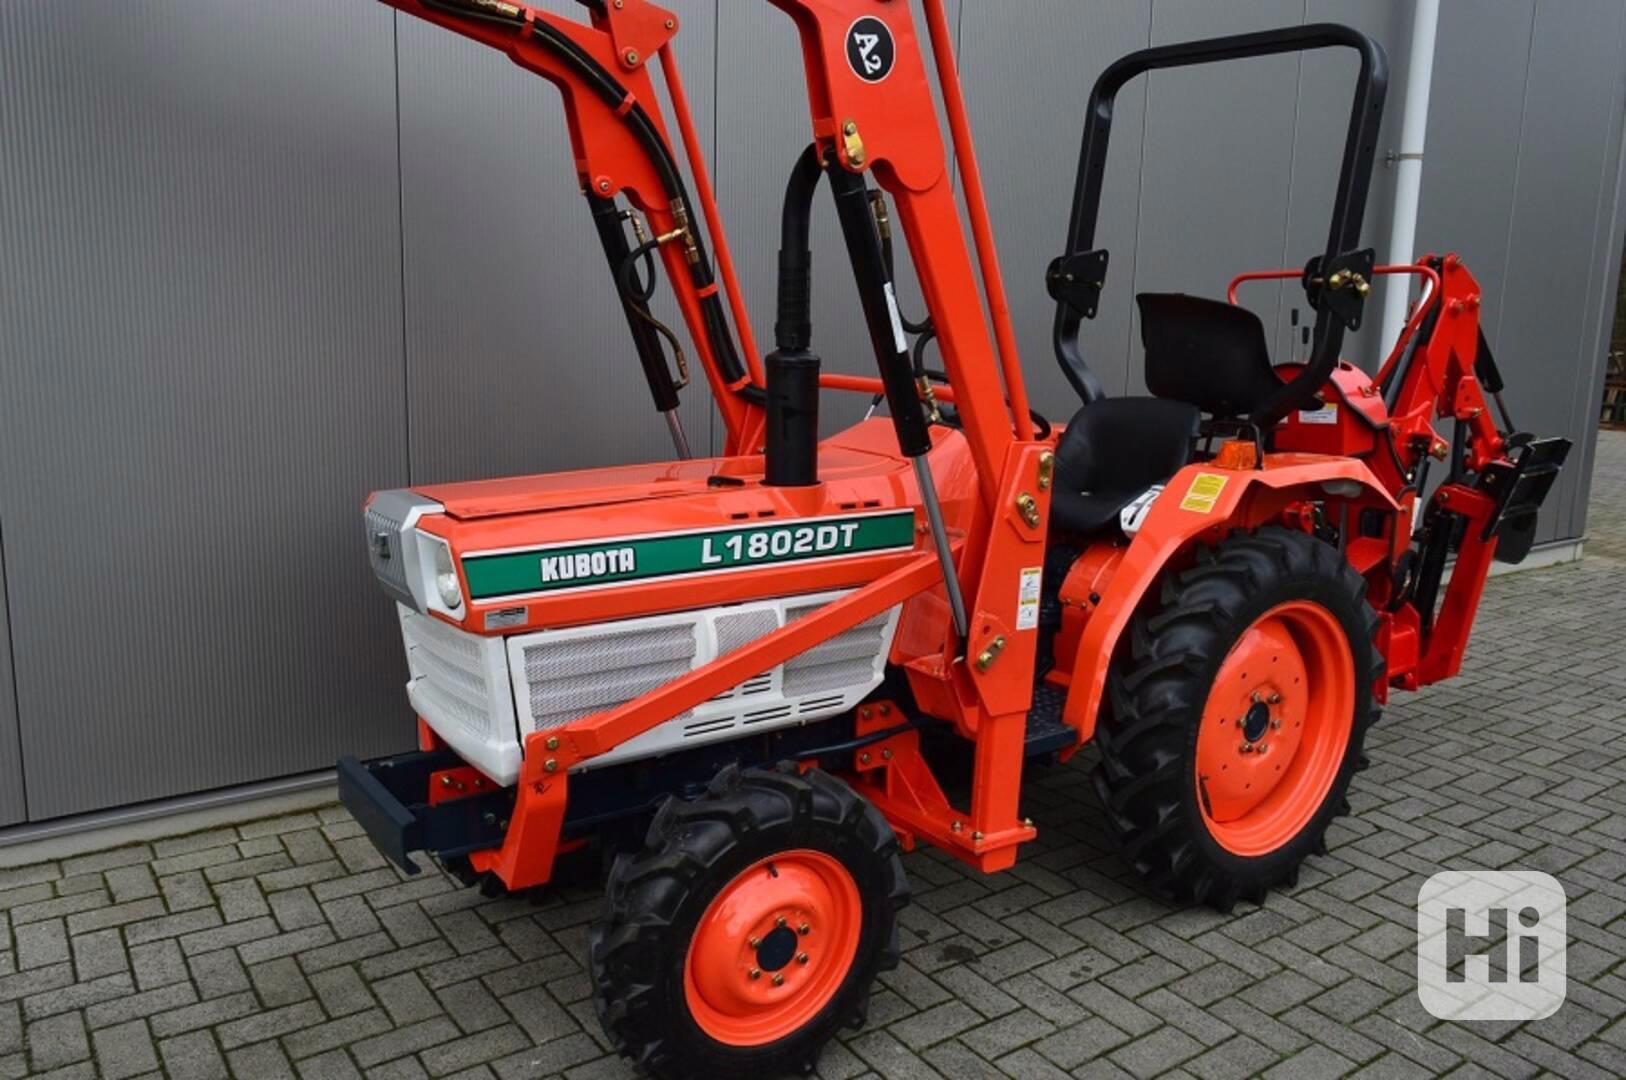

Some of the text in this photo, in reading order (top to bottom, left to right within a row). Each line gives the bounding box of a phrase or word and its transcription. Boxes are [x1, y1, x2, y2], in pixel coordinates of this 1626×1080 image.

[853, 32, 882, 75] A2
[541, 523, 859, 582] KUBOTA L1802DT
